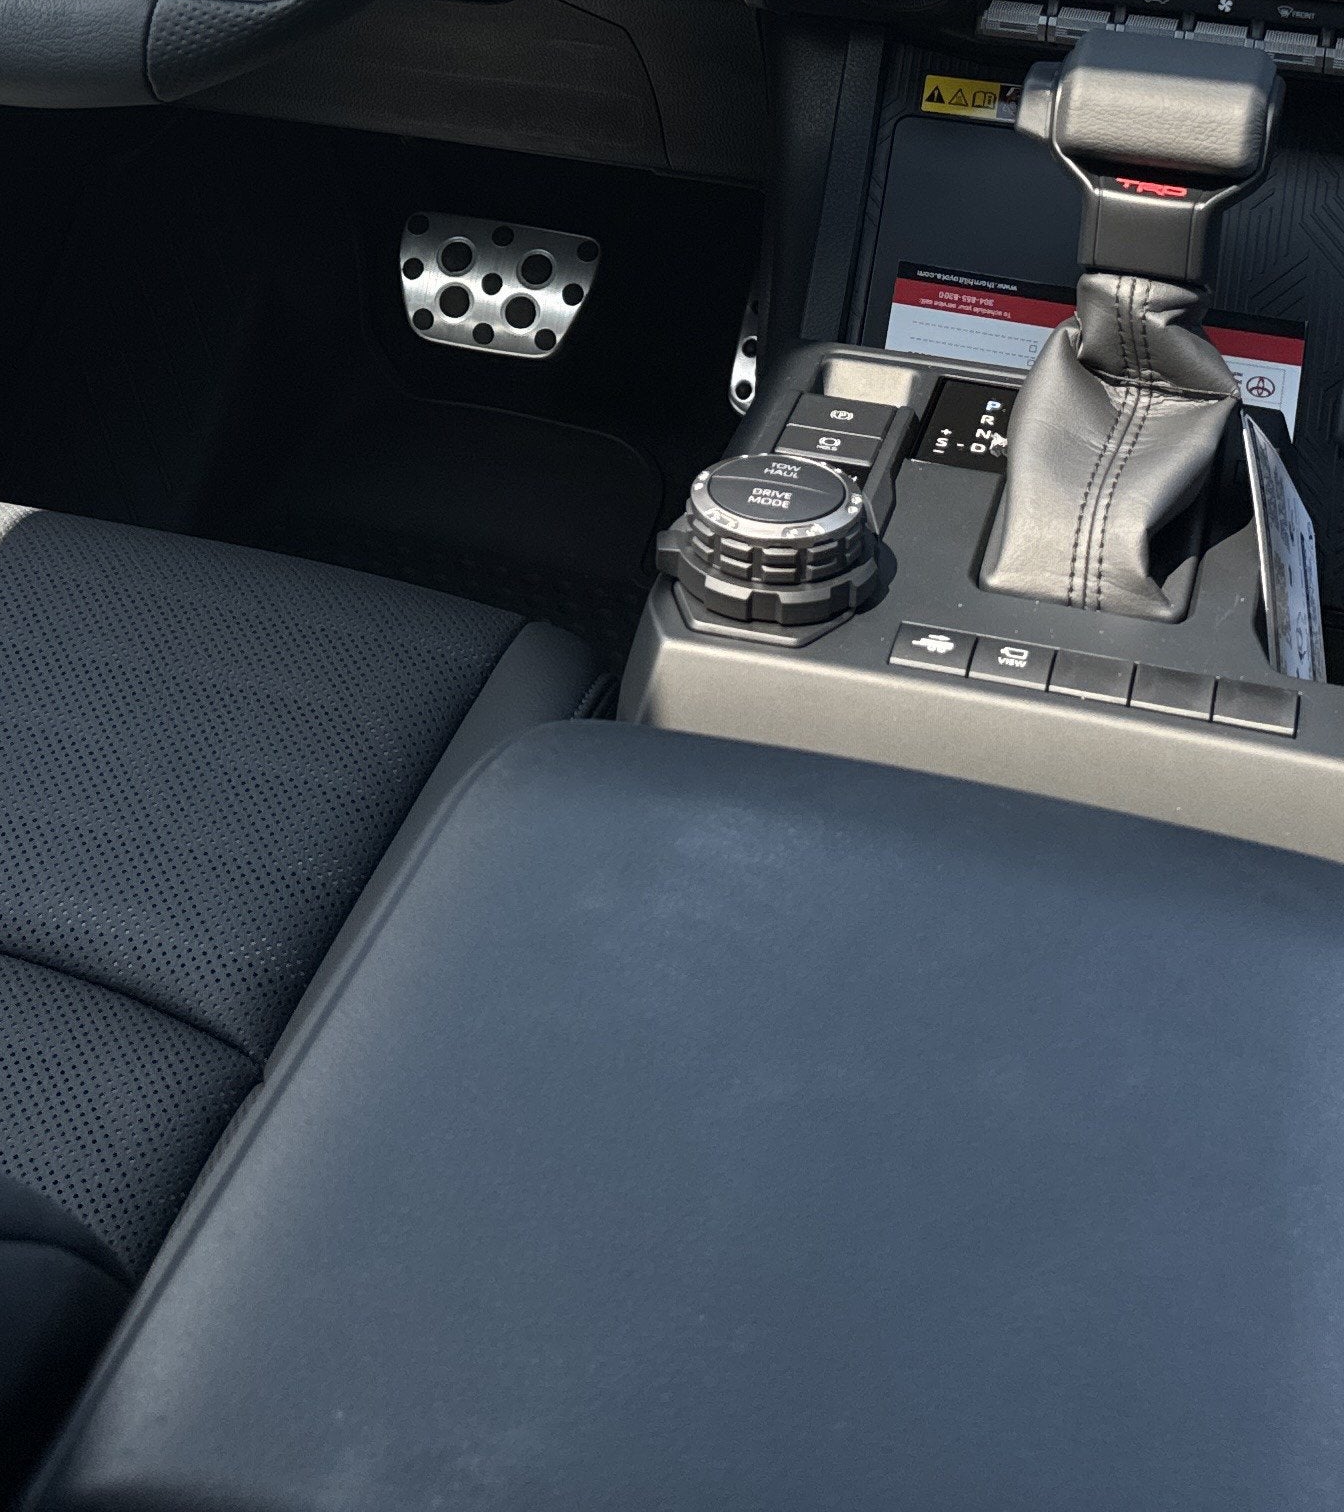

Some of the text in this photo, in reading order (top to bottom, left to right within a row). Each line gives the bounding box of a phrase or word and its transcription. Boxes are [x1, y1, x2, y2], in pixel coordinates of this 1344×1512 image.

[1115, 177, 1188, 198] TRD
[986, 400, 1002, 411] P
[980, 414, 995, 426] R
[975, 428, 992, 439] N
[935, 437, 949, 447] S
[970, 442, 987, 453] D
[771, 462, 801, 472] TOW
[763, 468, 799, 479] HAUL
[752, 487, 792, 500] DRIVE
[747, 495, 791, 509] MODE
[998, 656, 1027, 668] VIEW
